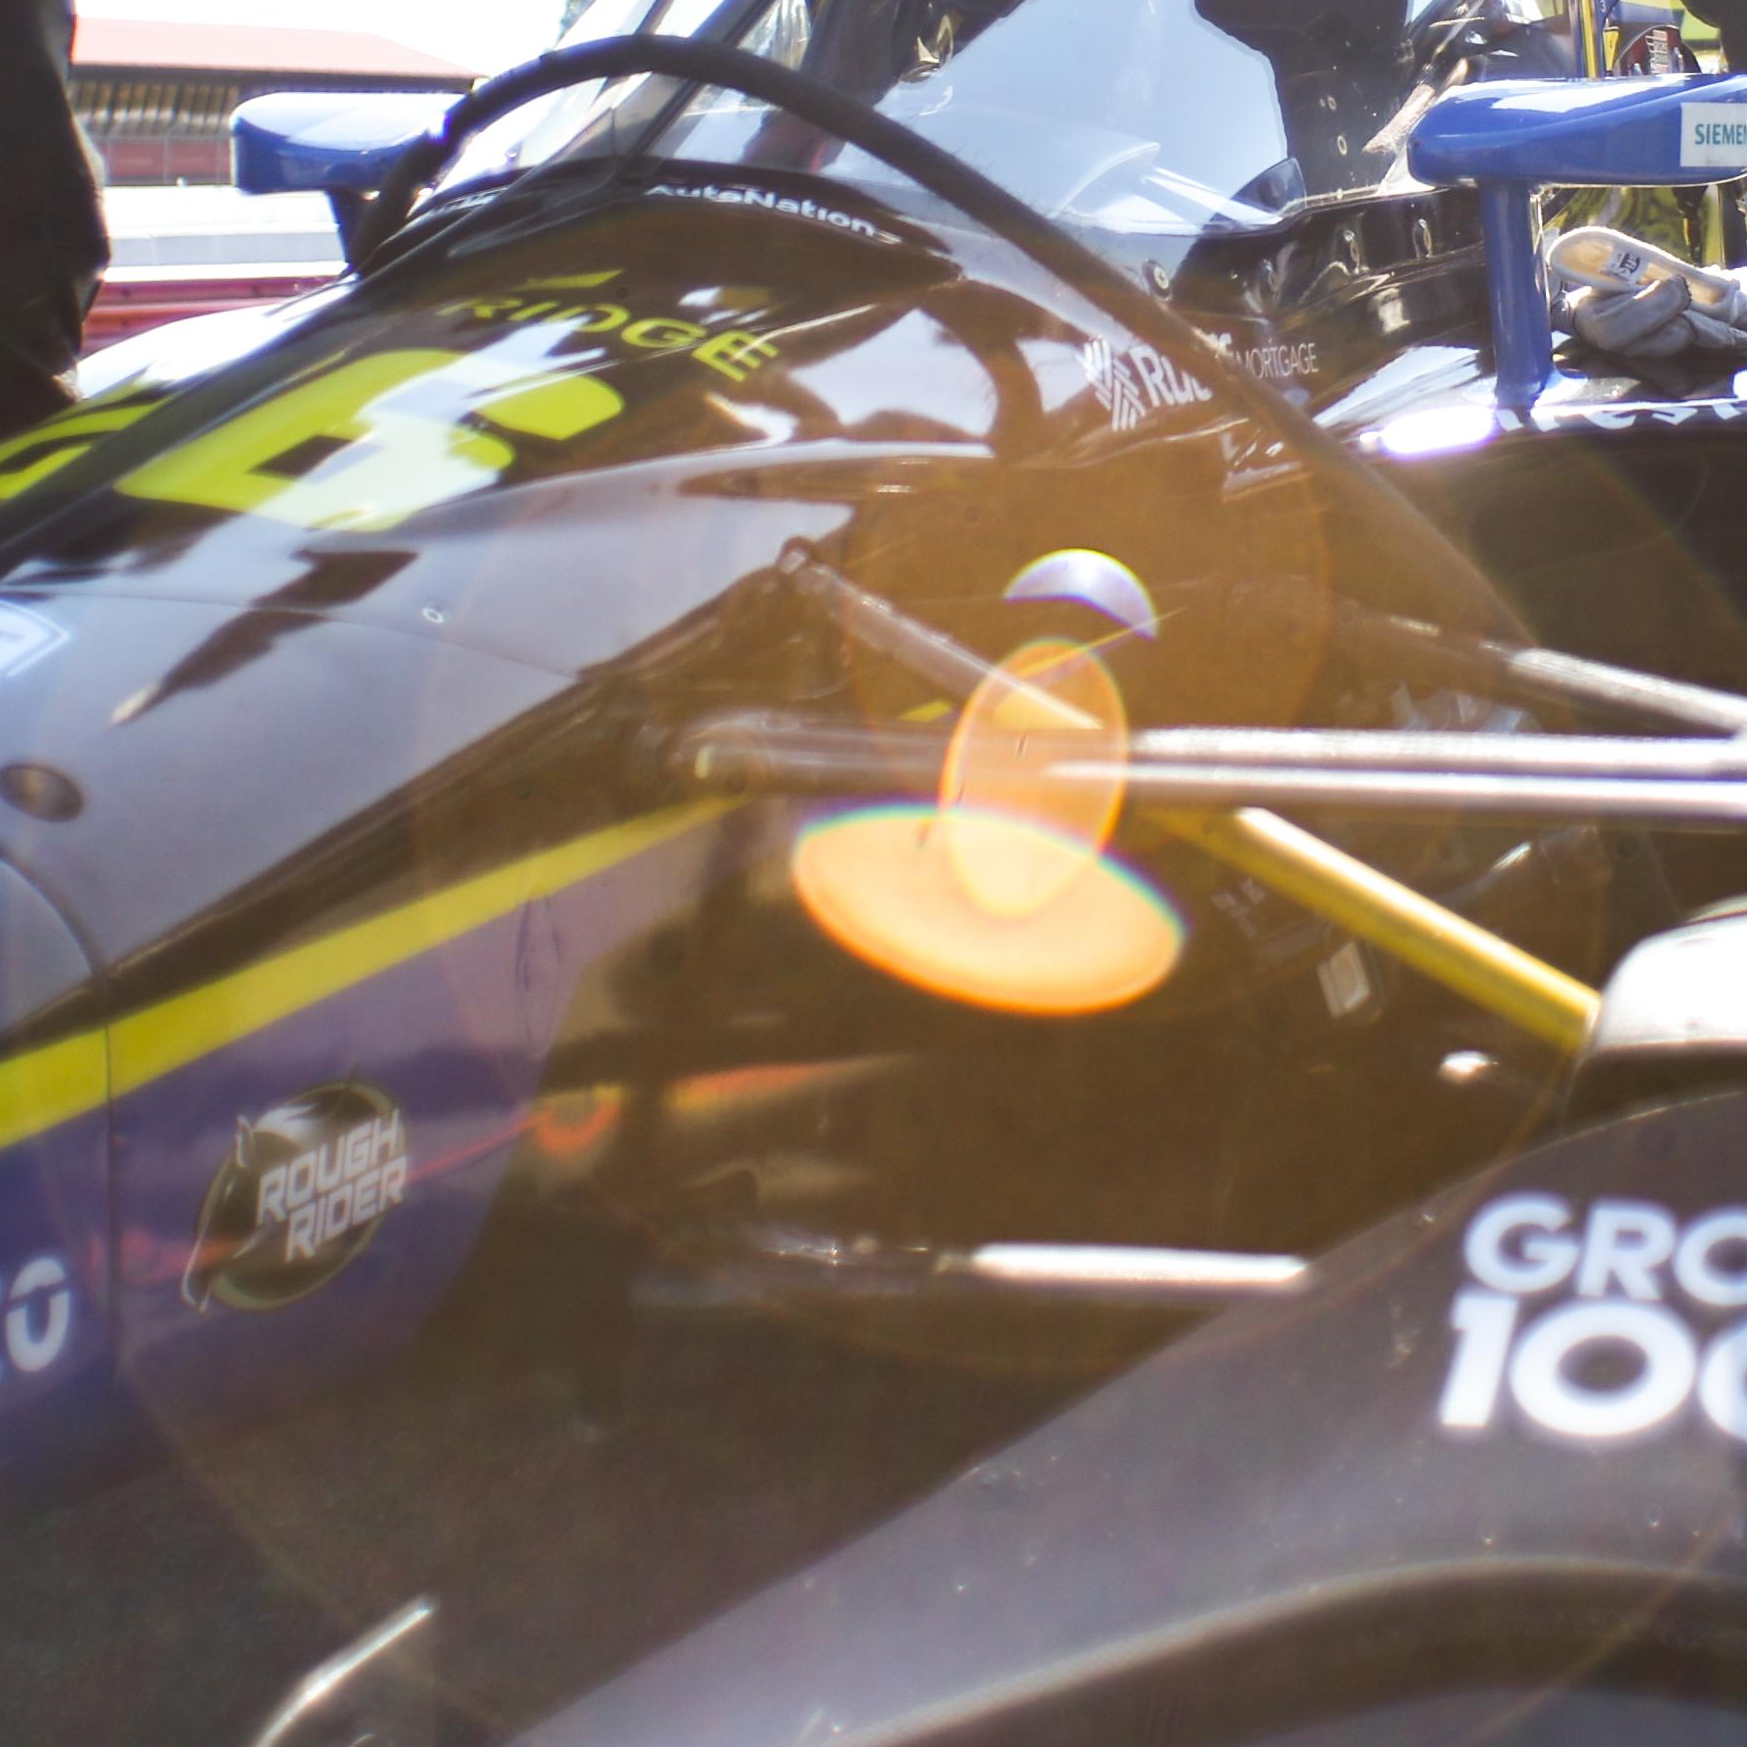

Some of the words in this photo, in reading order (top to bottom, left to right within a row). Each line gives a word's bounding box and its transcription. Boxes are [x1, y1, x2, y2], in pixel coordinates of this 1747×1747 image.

[646, 183, 876, 238] AutoNation
[437, 297, 780, 382] RIDGE
[256, 1108, 401, 1225] ROUGH
[286, 1155, 409, 1262] RIDER
